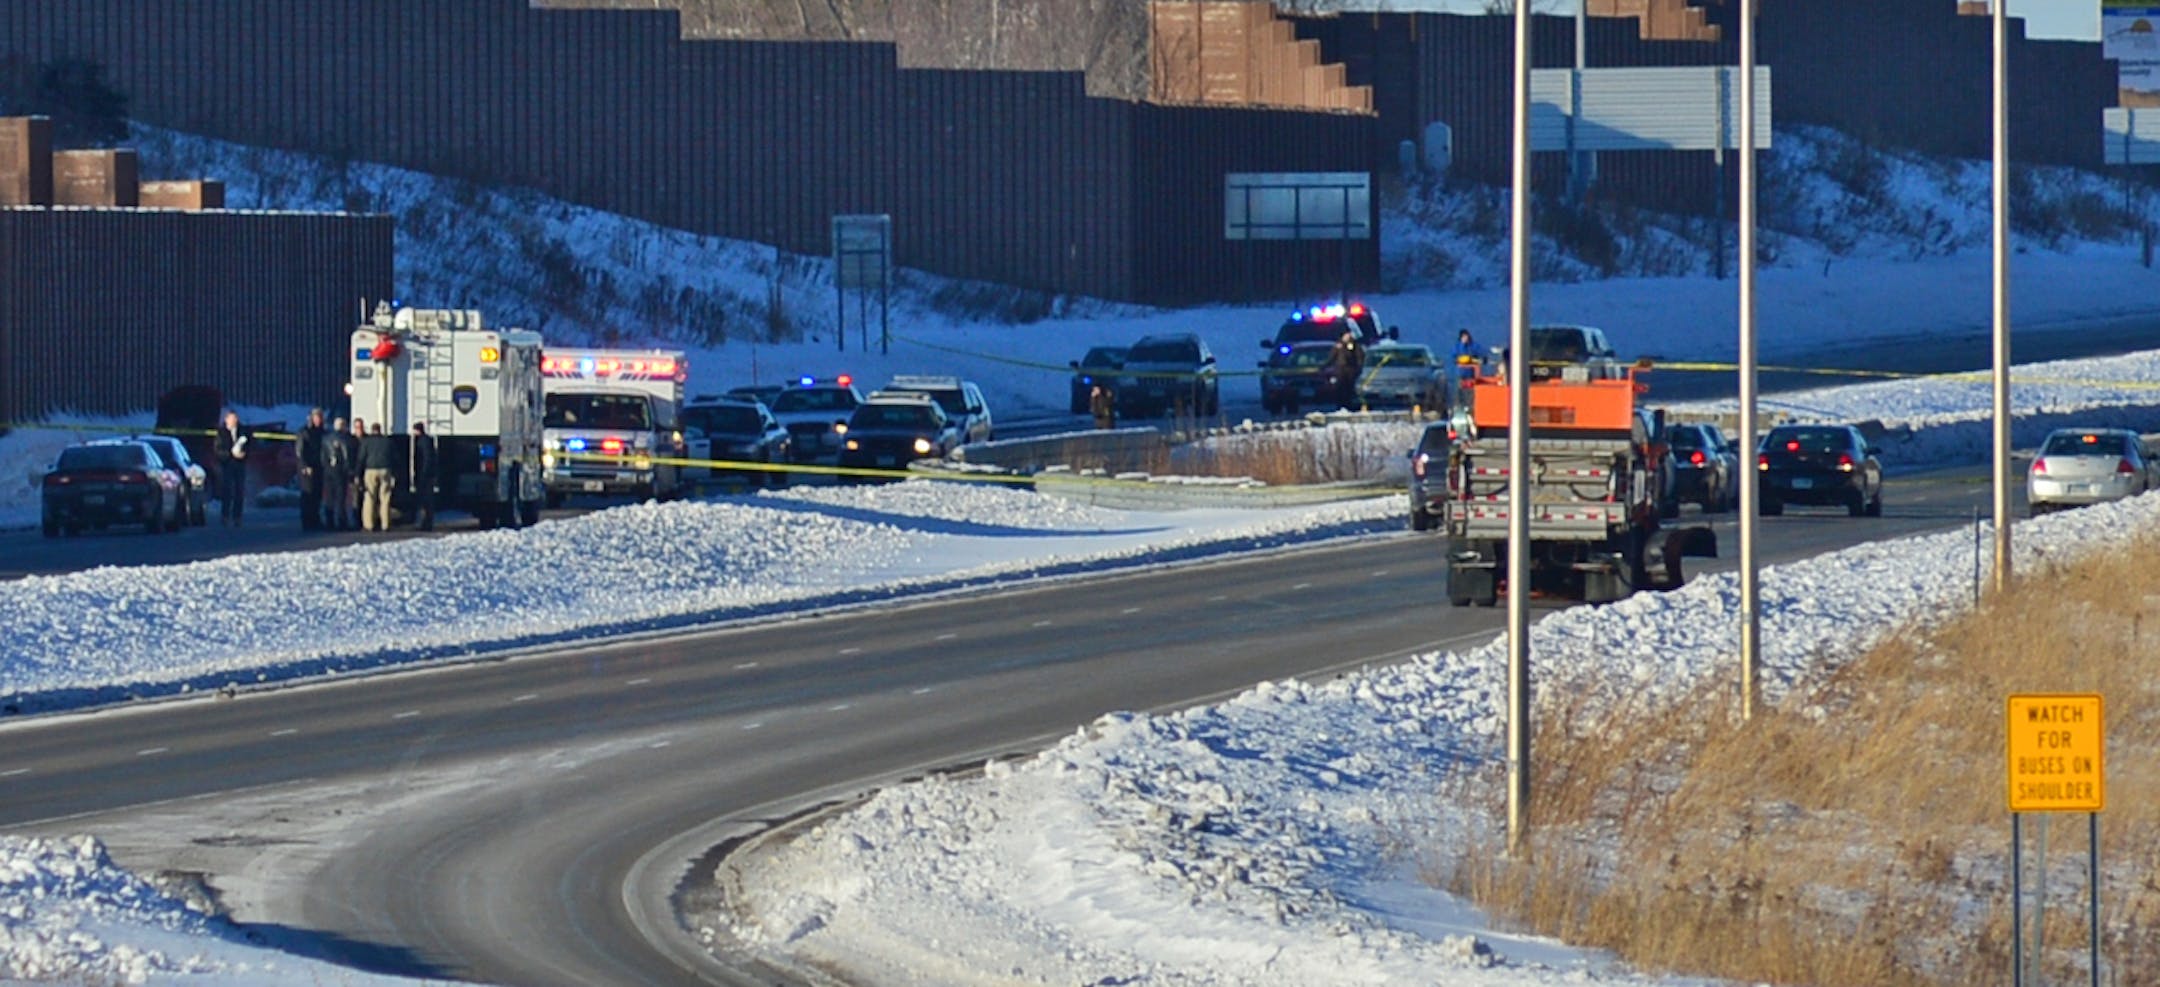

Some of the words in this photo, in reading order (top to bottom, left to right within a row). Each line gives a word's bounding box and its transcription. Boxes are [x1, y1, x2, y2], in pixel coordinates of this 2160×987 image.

[2027, 705, 2084, 722] WATCH
[2038, 731, 2072, 748] FOR
[2018, 756, 2065, 774] BUSES
[2072, 756, 2092, 774] ON
[2018, 782, 2093, 800] SHOULDER
